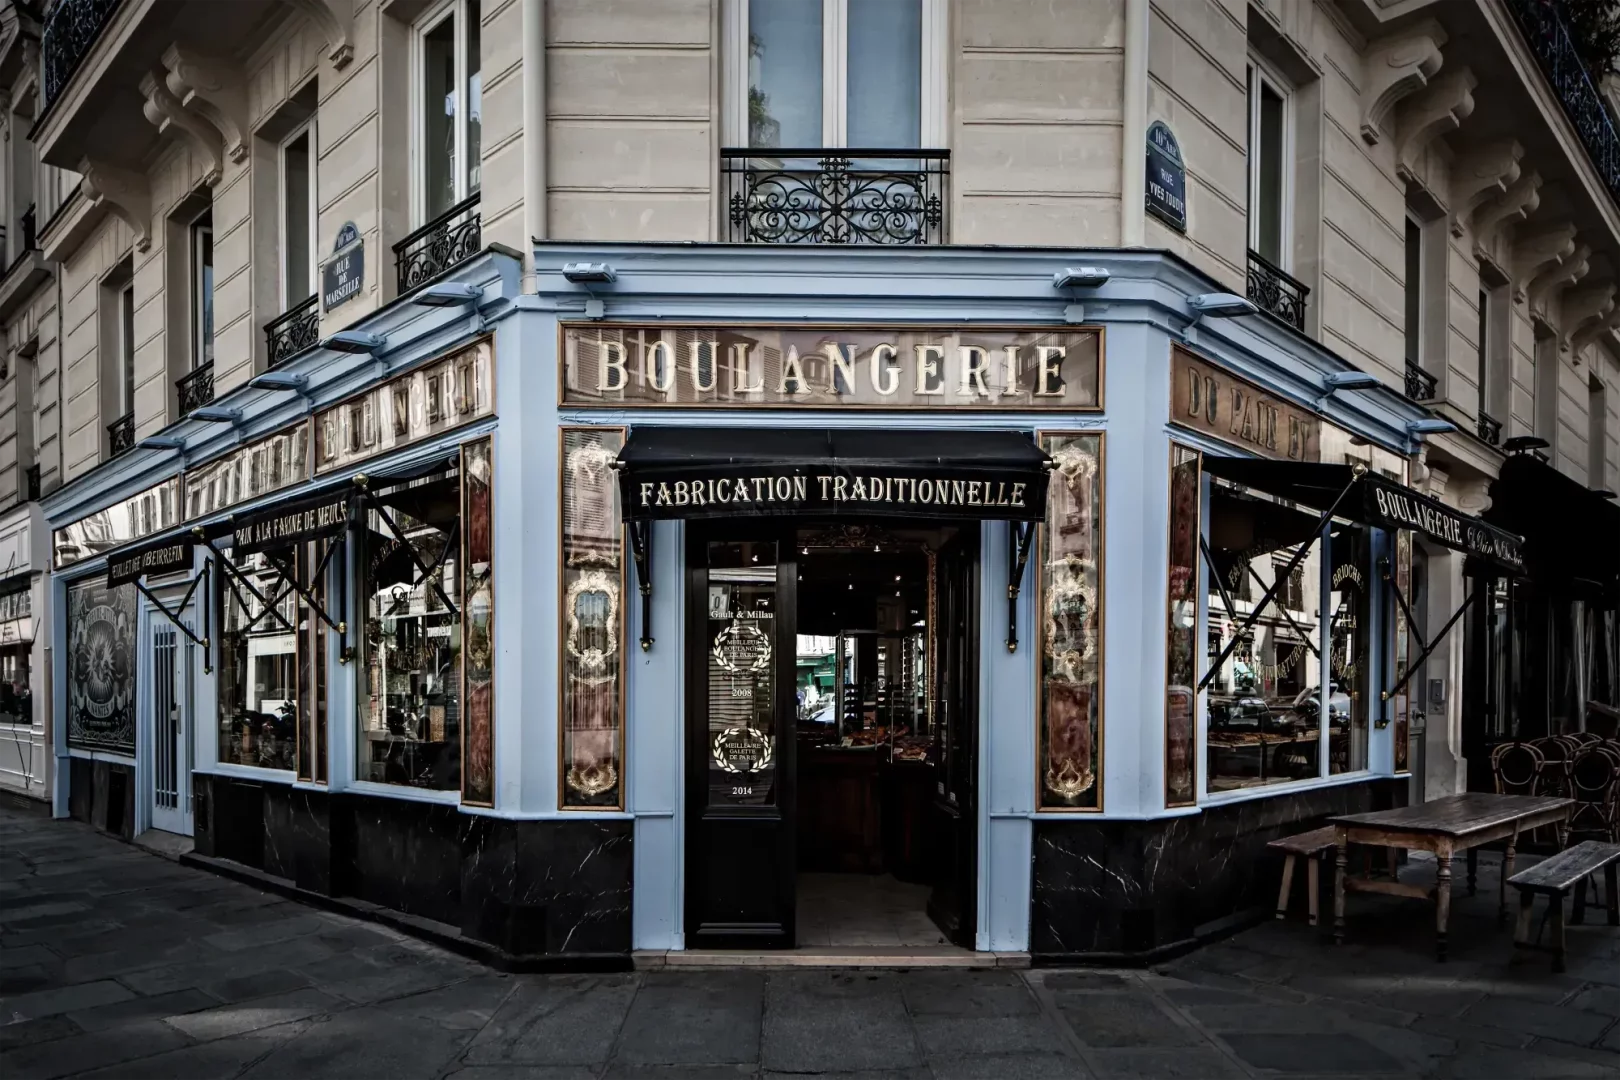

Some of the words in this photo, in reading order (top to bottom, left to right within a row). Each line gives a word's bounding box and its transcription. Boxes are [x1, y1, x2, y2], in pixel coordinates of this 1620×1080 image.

[1160, 167, 1174, 187] RUE
[1149, 180, 1165, 201] YVES
[335, 256, 350, 275] RUE
[338, 271, 348, 286] DE
[325, 276, 360, 306] MARSEILLE
[596, 340, 1067, 397] BOULANGERIE
[1188, 366, 1220, 427] DU
[1230, 387, 1279, 452] PAIN
[639, 476, 808, 507] FABRICATION
[816, 476, 1028, 508] TRADITIONNELLE
[235, 525, 252, 546] PAIN
[261, 521, 272, 541] LA
[304, 508, 316, 531] DE
[317, 500, 347, 528] MEULE
[1376, 487, 1463, 546] BOULANGERIE
[711, 610, 734, 619] Gault
[736, 610, 744, 619] &
[747, 610, 774, 619] Millau
[732, 688, 752, 697] 2008
[732, 786, 752, 795] 2014
